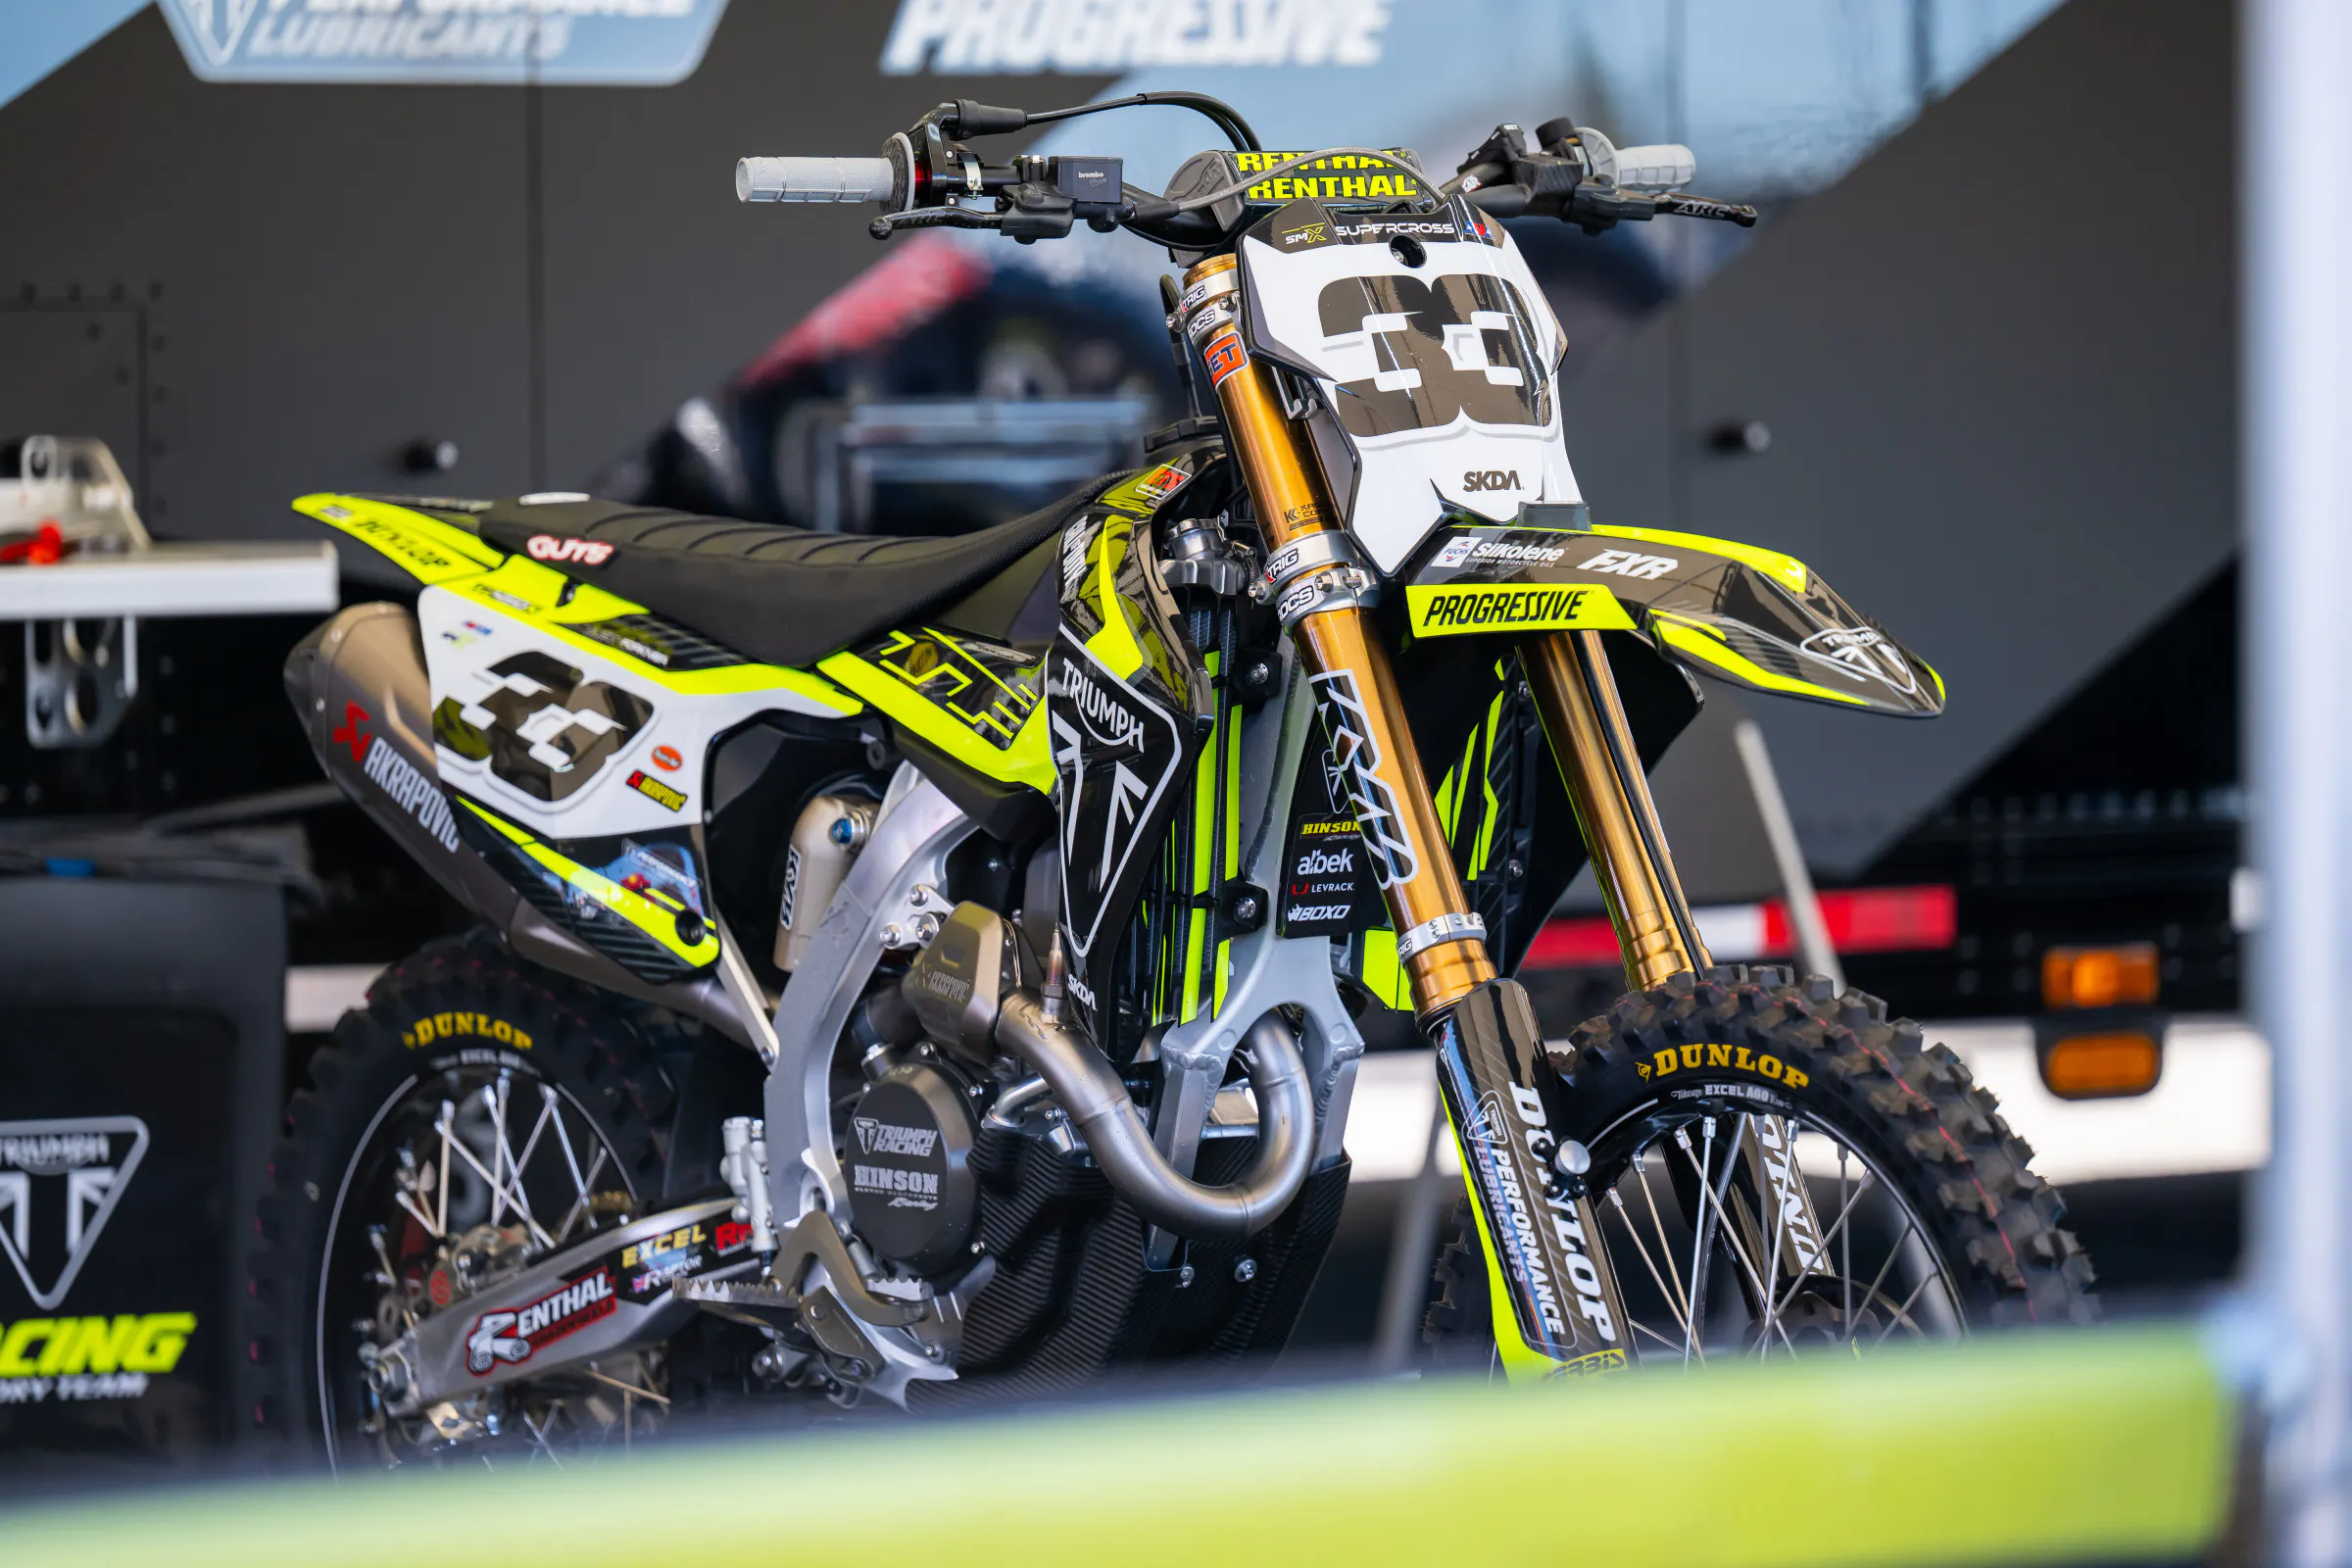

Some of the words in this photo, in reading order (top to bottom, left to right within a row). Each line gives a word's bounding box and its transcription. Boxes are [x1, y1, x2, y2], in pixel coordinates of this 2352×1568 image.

[1249, 174, 1417, 199] RENTHAL
[1285, 227, 1327, 245] SMX
[1335, 222, 1455, 237] SUPERCROSS
[1188, 310, 1215, 339] OCS
[1207, 342, 1237, 374] ET
[1318, 274, 1552, 438] 33
[1463, 470, 1521, 492] SKDA
[527, 535, 613, 565] GUTS
[1472, 542, 1565, 562] Silkolene
[1497, 559, 1538, 567] MOTORCYCLE
[1577, 548, 1679, 581] FXR
[1423, 590, 1590, 627] PROGRESSIVE
[1062, 658, 1145, 754] TRIUMPH
[432, 651, 655, 803] 33
[1297, 848, 1354, 875] albek
[1311, 882, 1353, 893] LEVRACK
[1298, 905, 1351, 921] BOXO
[415, 1011, 533, 1049] DUNLOP
[1653, 1044, 1809, 1090] DUNLOP
[1704, 1084, 1744, 1099] EXCEL
[1746, 1085, 1769, 1102] A60
[0, 1133, 110, 1166] RIUMPH
[872, 1138, 933, 1157] RACING
[877, 1124, 938, 1147] TRIUMPH
[855, 1164, 938, 1195] HINSON
[621, 1223, 708, 1269] EXCEL
[1492, 1148, 1566, 1336] PERFORMANCE
[0, 1312, 197, 1379] CING
